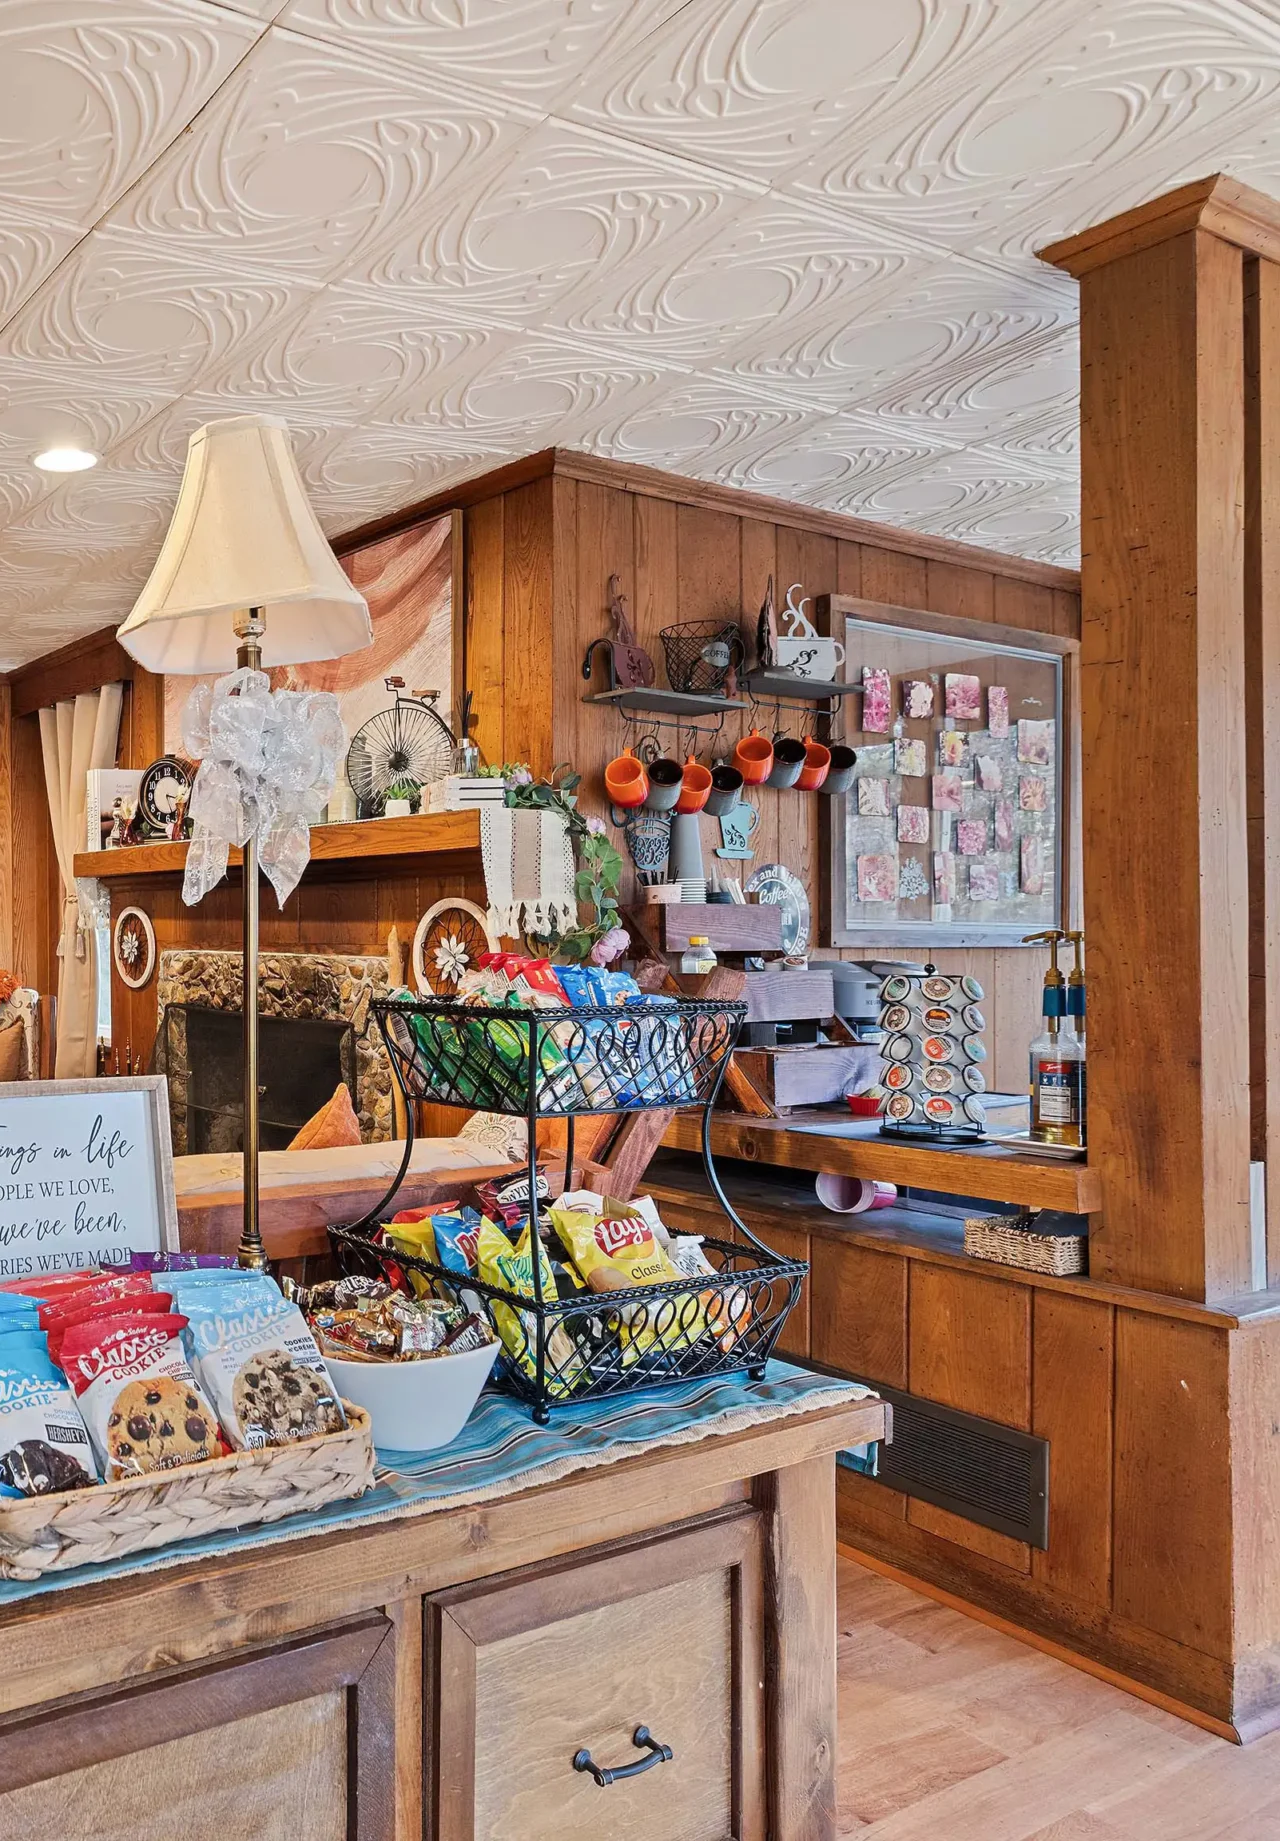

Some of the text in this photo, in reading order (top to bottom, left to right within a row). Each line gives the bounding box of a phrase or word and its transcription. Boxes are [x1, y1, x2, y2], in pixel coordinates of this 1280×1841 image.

[759, 887, 789, 904] Coffee
[53, 1144, 72, 1158] in
[80, 1114, 135, 1168] life
[38, 1180, 64, 1199] WE
[69, 1177, 115, 1196] LOVE,
[501, 1178, 547, 1203] SNYD'S
[0, 1217, 66, 1242] we've
[74, 1200, 127, 1235] been,
[600, 1216, 649, 1253] Lays
[36, 1252, 84, 1272] WE'VE
[87, 1246, 131, 1267] MADE
[200, 1300, 292, 1351] Classic
[231, 1324, 285, 1353] COOKIE
[284, 1336, 313, 1346] COOKIES
[112, 1346, 166, 1381] COOKIE
[159, 1361, 186, 1373] CHOCOLA
[47, 1425, 87, 1443] HERSHEY'S
[289, 1424, 326, 1437] Delicious
[149, 1457, 167, 1472] Soft
[172, 1449, 210, 1467] Delicious
